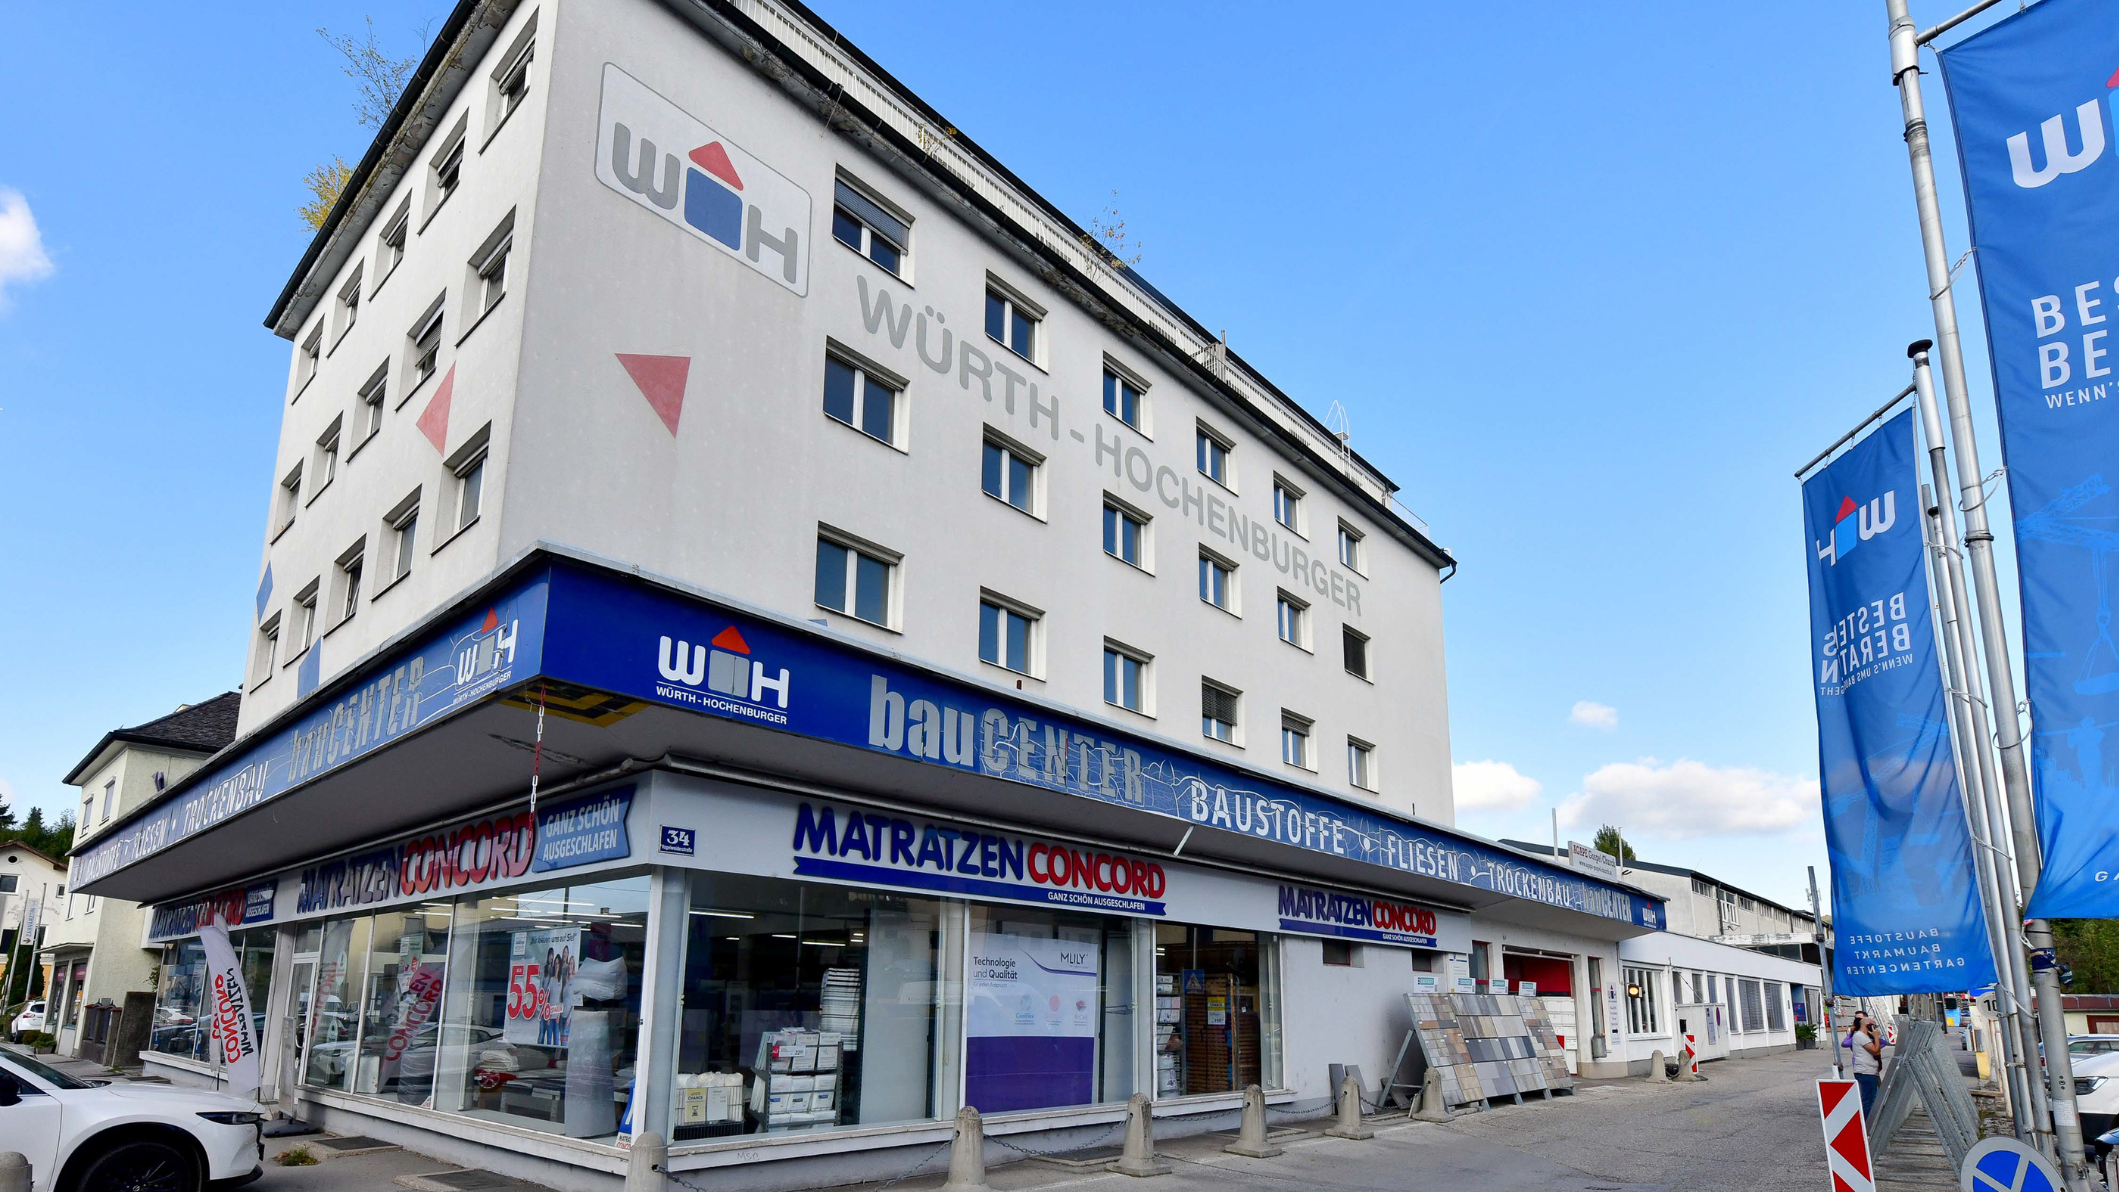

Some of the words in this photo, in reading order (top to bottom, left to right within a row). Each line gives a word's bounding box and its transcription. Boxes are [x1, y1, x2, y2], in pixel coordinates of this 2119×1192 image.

[2030, 275, 2119, 339] BE
[2044, 379, 2119, 409] WENN'
[182, 760, 269, 836] TROCKENBAU
[545, 809, 576, 838] GANZ
[577, 795, 621, 832] SCHÖN
[400, 811, 536, 897] CONCORD
[542, 828, 618, 862] AUSGESCHLAFEN
[666, 829, 691, 847] 34
[793, 802, 1025, 882] MATRATZEN
[1027, 841, 1167, 899] CONCORD
[1190, 780, 1345, 855] BAUSTOFFE
[1387, 835, 1458, 882] FLIESEN
[1487, 861, 1570, 906] TROCKENBAU
[1047, 891, 1068, 902] GANZ
[1068, 893, 1093, 905] SCHÖN
[1093, 897, 1146, 911] AUSGESCHLAFEN
[1278, 884, 1373, 927] MATRATZEN
[1372, 900, 1437, 936] CONCORD
[973, 956, 1016, 970] Technologie
[973, 969, 987, 978] und
[988, 968, 1019, 980] Qualität
[1060, 952, 1086, 965] MLILY
